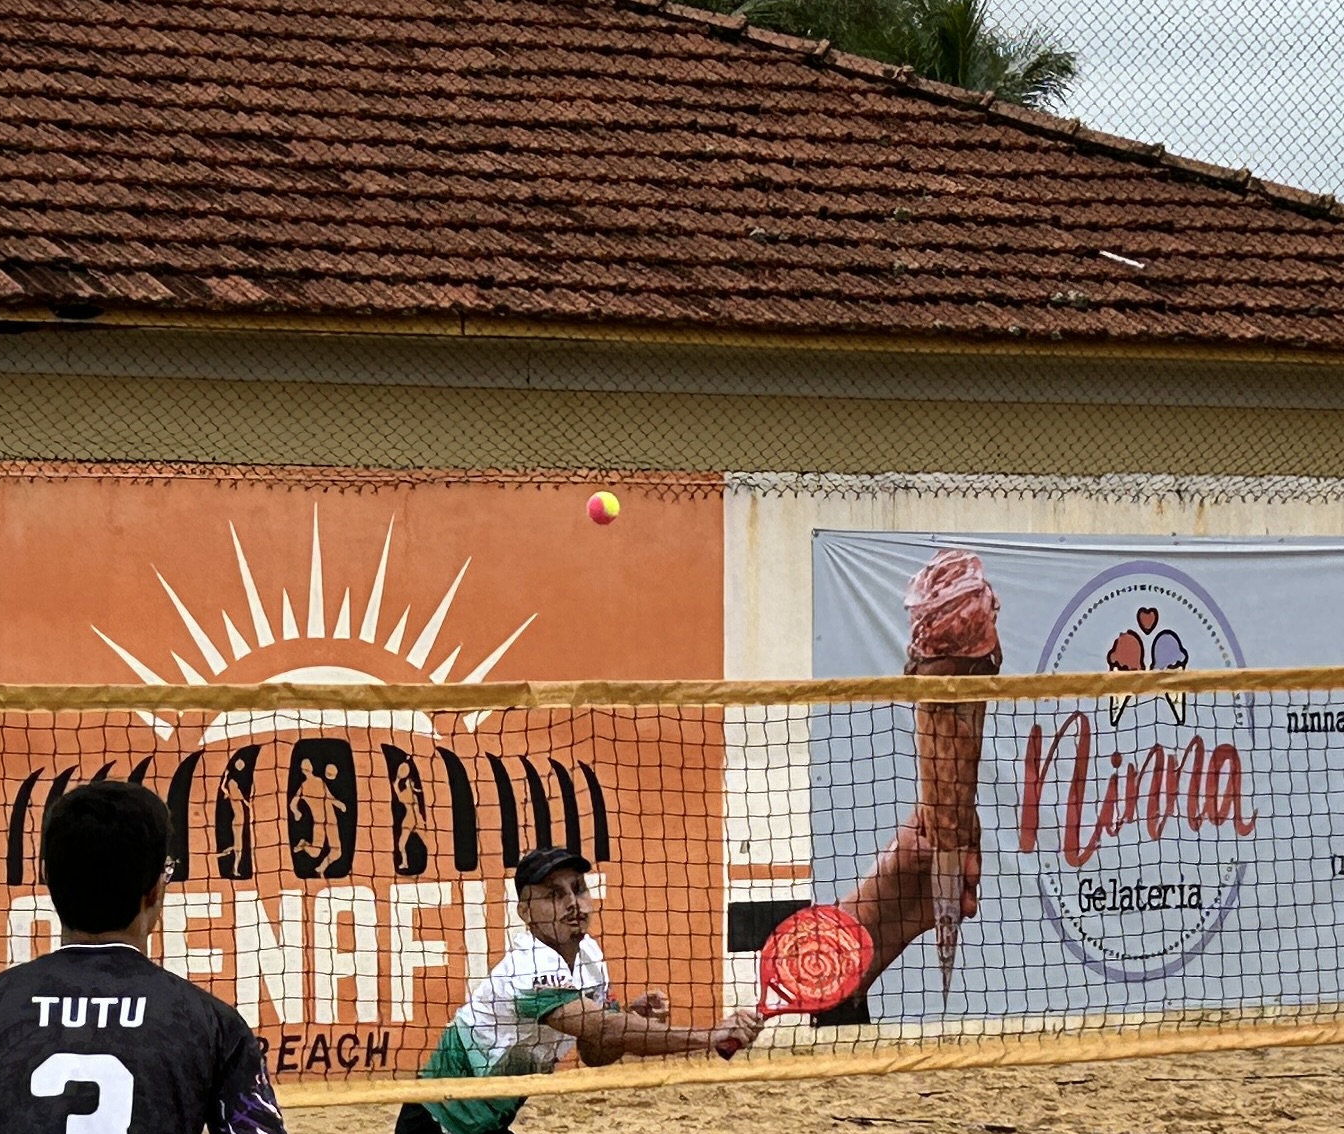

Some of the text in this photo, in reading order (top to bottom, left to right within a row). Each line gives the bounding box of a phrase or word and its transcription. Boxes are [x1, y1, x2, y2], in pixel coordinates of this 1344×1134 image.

[1020, 710, 1259, 868] Ninna
[1078, 878, 1203, 913] Gelateria
[31, 996, 147, 1029] TUTU
